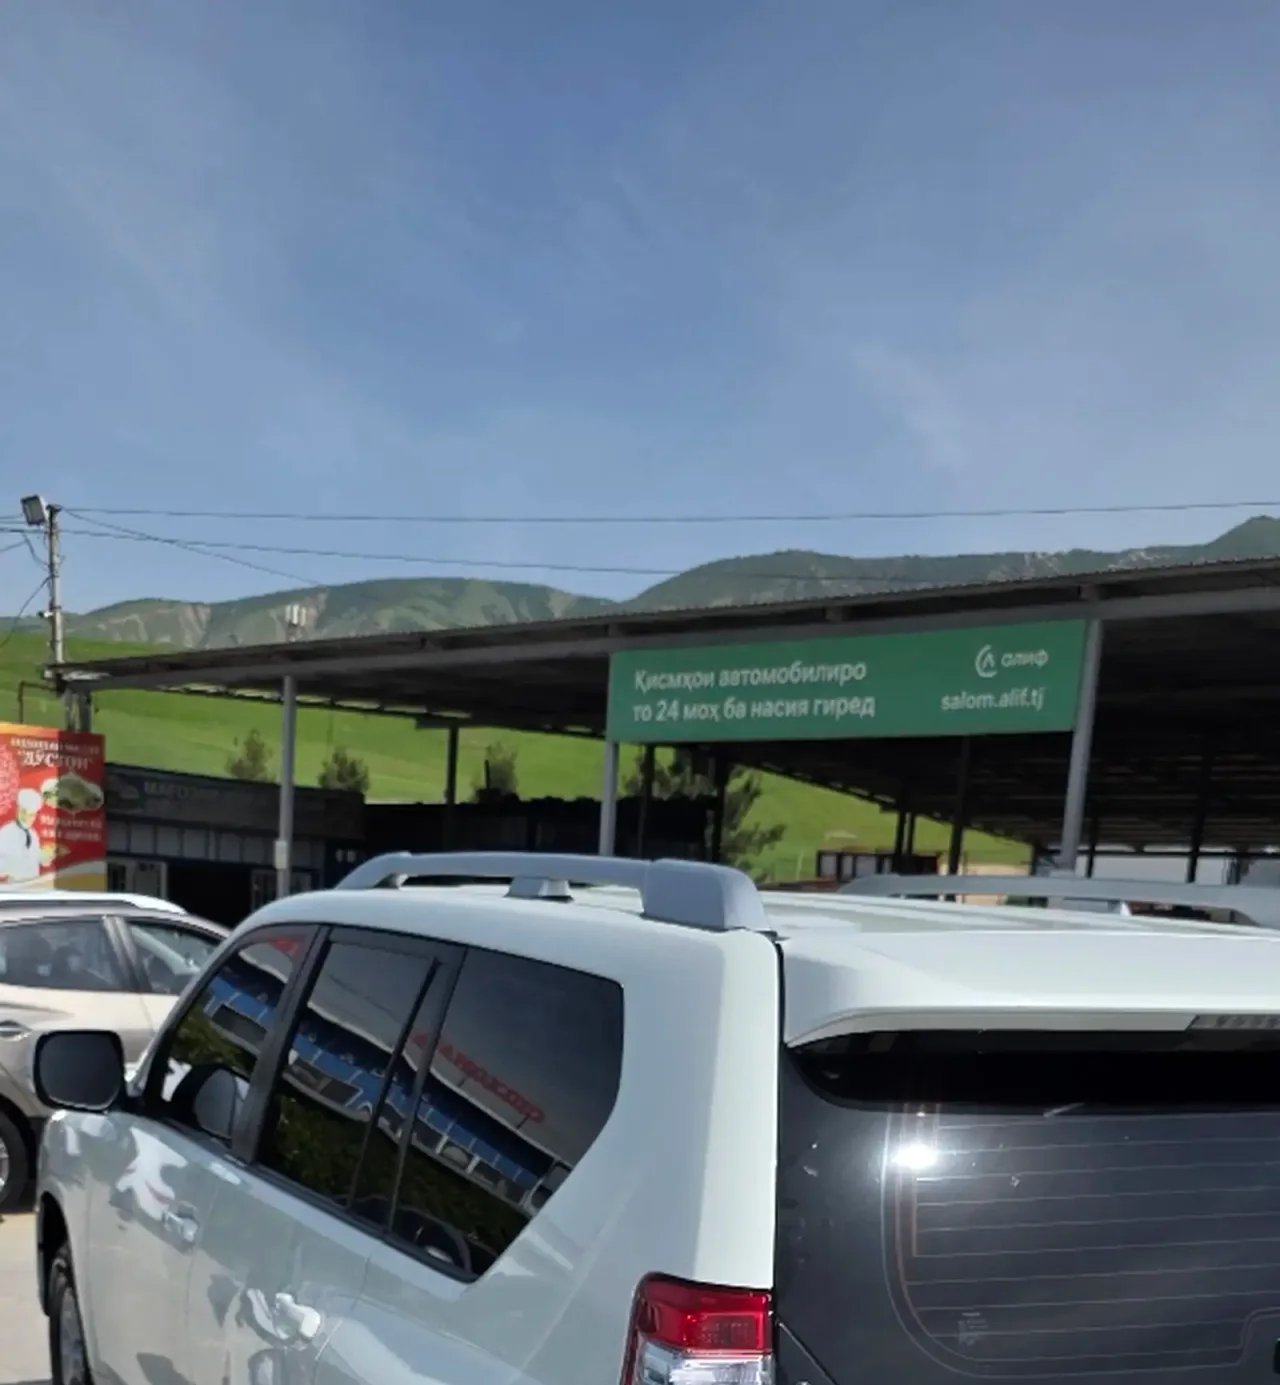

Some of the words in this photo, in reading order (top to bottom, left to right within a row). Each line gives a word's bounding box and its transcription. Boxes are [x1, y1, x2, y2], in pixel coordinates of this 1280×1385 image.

[718, 660, 867, 688] автомобилиро
[633, 703, 652, 722] то
[655, 700, 679, 722] 24
[723, 697, 747, 720] ба
[751, 699, 808, 719] насия
[813, 696, 876, 720] гиред
[941, 686, 1045, 711] salom.alif.tj
